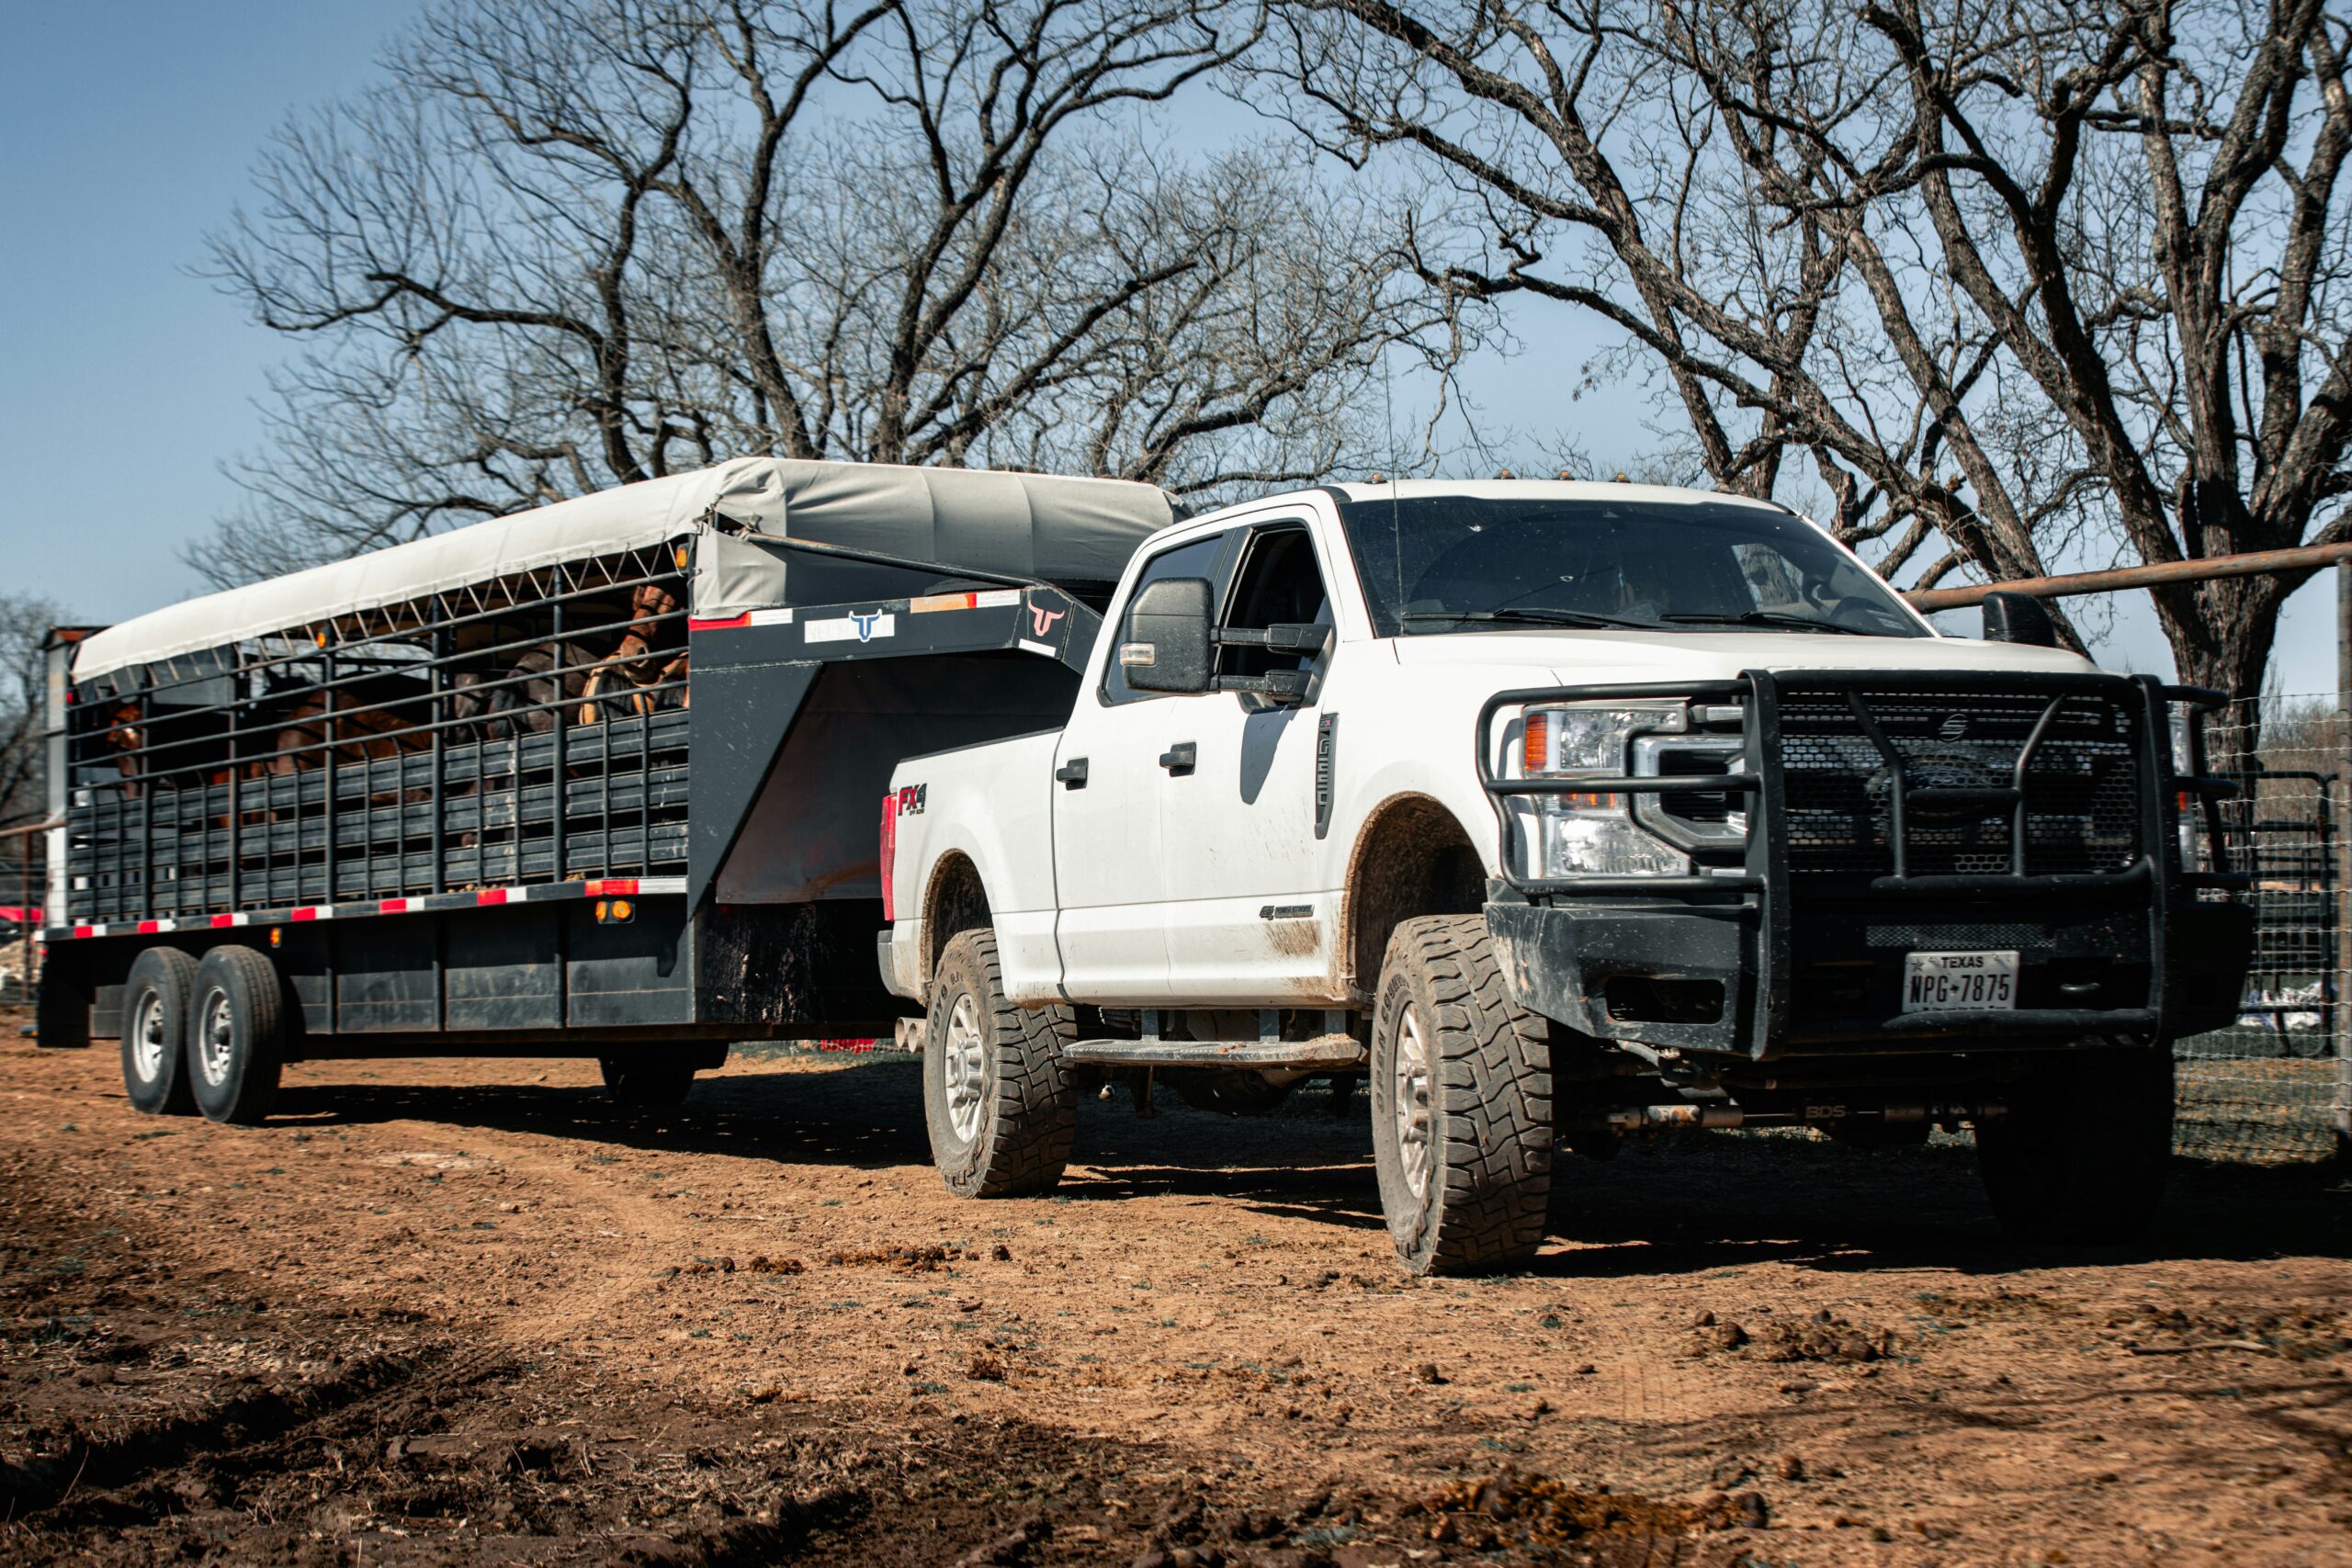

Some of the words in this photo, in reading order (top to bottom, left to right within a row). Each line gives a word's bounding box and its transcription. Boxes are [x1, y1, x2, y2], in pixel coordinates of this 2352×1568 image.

[898, 783, 927, 817] FX4
[1941, 956, 1984, 968] TEXAS
[1910, 976, 1948, 1003] NPG
[1961, 974, 2010, 1002] 7875
[931, 984, 947, 1043] TOYO
